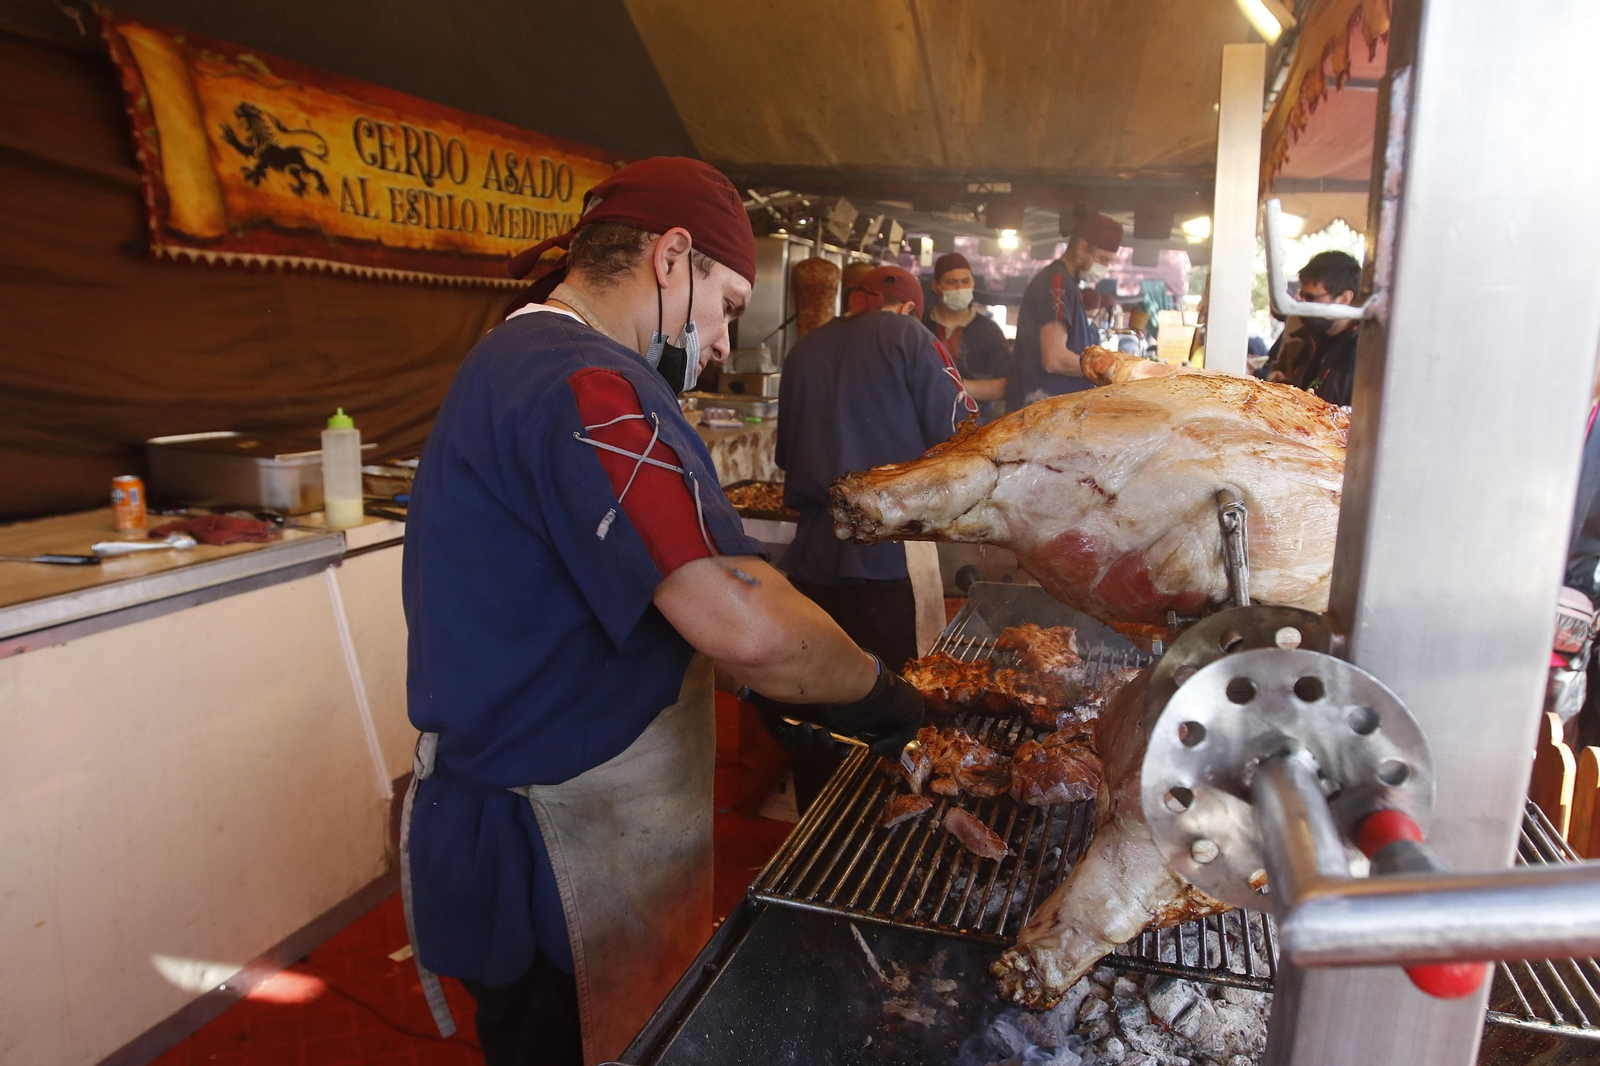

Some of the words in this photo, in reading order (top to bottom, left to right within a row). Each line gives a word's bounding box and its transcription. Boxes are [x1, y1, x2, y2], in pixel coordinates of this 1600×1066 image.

[354, 116, 469, 186] CERDO
[482, 148, 573, 202] ASADO
[339, 175, 379, 220] AL
[387, 186, 478, 234] ESTILO
[485, 201, 582, 241] MEDIEVA
